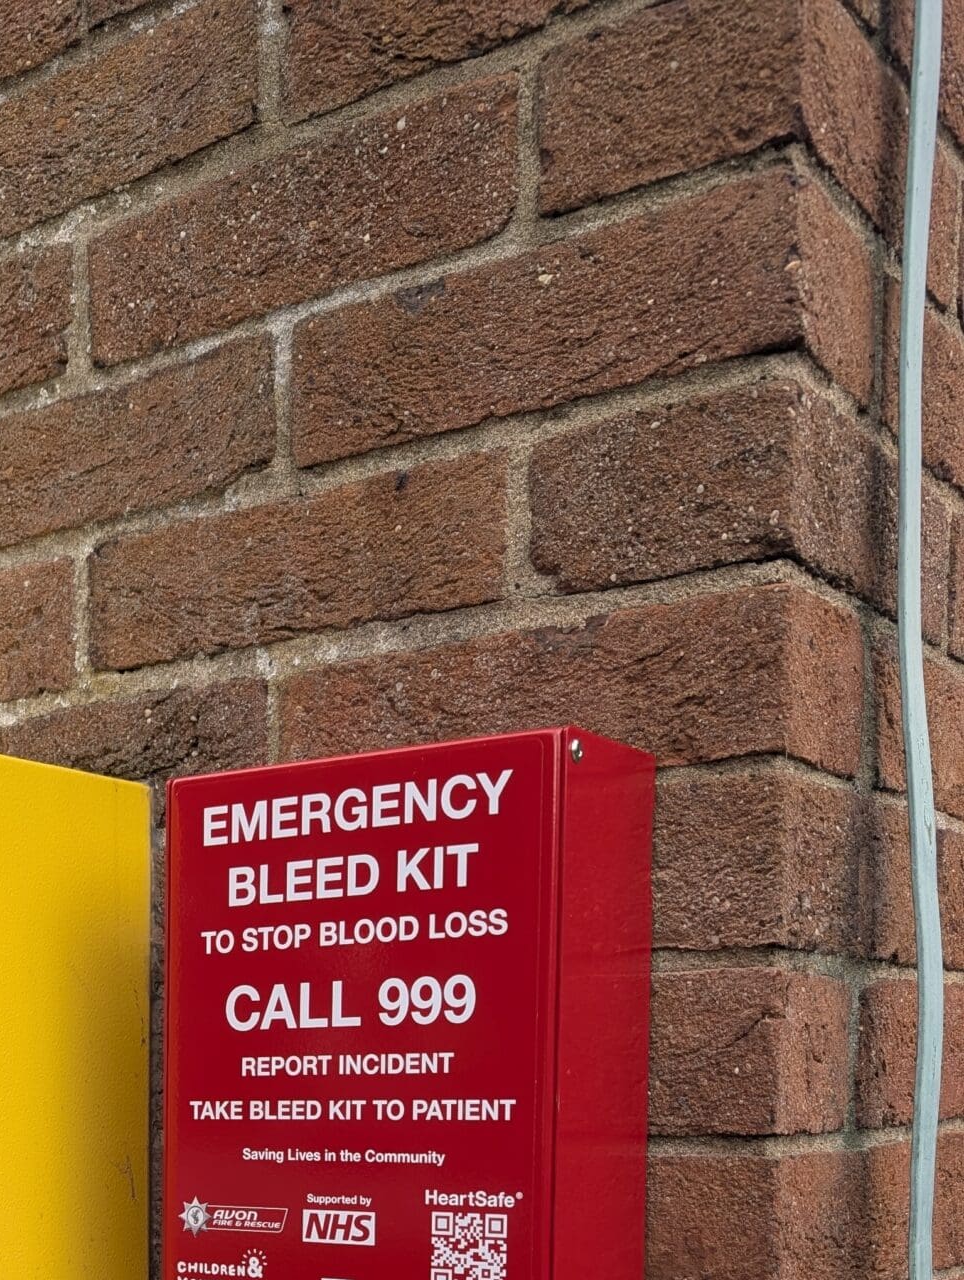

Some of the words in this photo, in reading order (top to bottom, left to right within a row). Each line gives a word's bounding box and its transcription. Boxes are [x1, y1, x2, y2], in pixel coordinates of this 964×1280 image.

[203, 769, 514, 847] EMERGENCY
[228, 853, 380, 907] BLEED
[397, 842, 479, 892] KIT
[201, 929, 235, 955] TO
[242, 923, 311, 953] STOP
[319, 915, 420, 947] BLOOD
[429, 908, 509, 939] LOSS
[225, 980, 361, 1032] CALL
[378, 974, 476, 1026] 999
[241, 1054, 332, 1077] REPORT
[339, 1052, 455, 1076] INCIDENT
[189, 1100, 243, 1120] TAKE
[249, 1100, 322, 1120] BLEED
[329, 1100, 366, 1120] KIT
[373, 1099, 405, 1121] TO
[412, 1099, 516, 1121] PATIENT
[242, 1147, 284, 1164] Saving
[287, 1148, 321, 1162] Lives
[324, 1149, 336, 1162] in
[339, 1149, 361, 1163] the
[365, 1149, 445, 1167] Community
[306, 1193, 357, 1206] Supported
[359, 1195, 372, 1207] by
[213, 1208, 258, 1221] AVON
[213, 1219, 233, 1227] FIRE
[244, 1220, 281, 1229] RESCUE
[305, 1212, 372, 1243] NHS
[177, 1261, 246, 1277] CHILDREN
[247, 1256, 263, 1279] &
